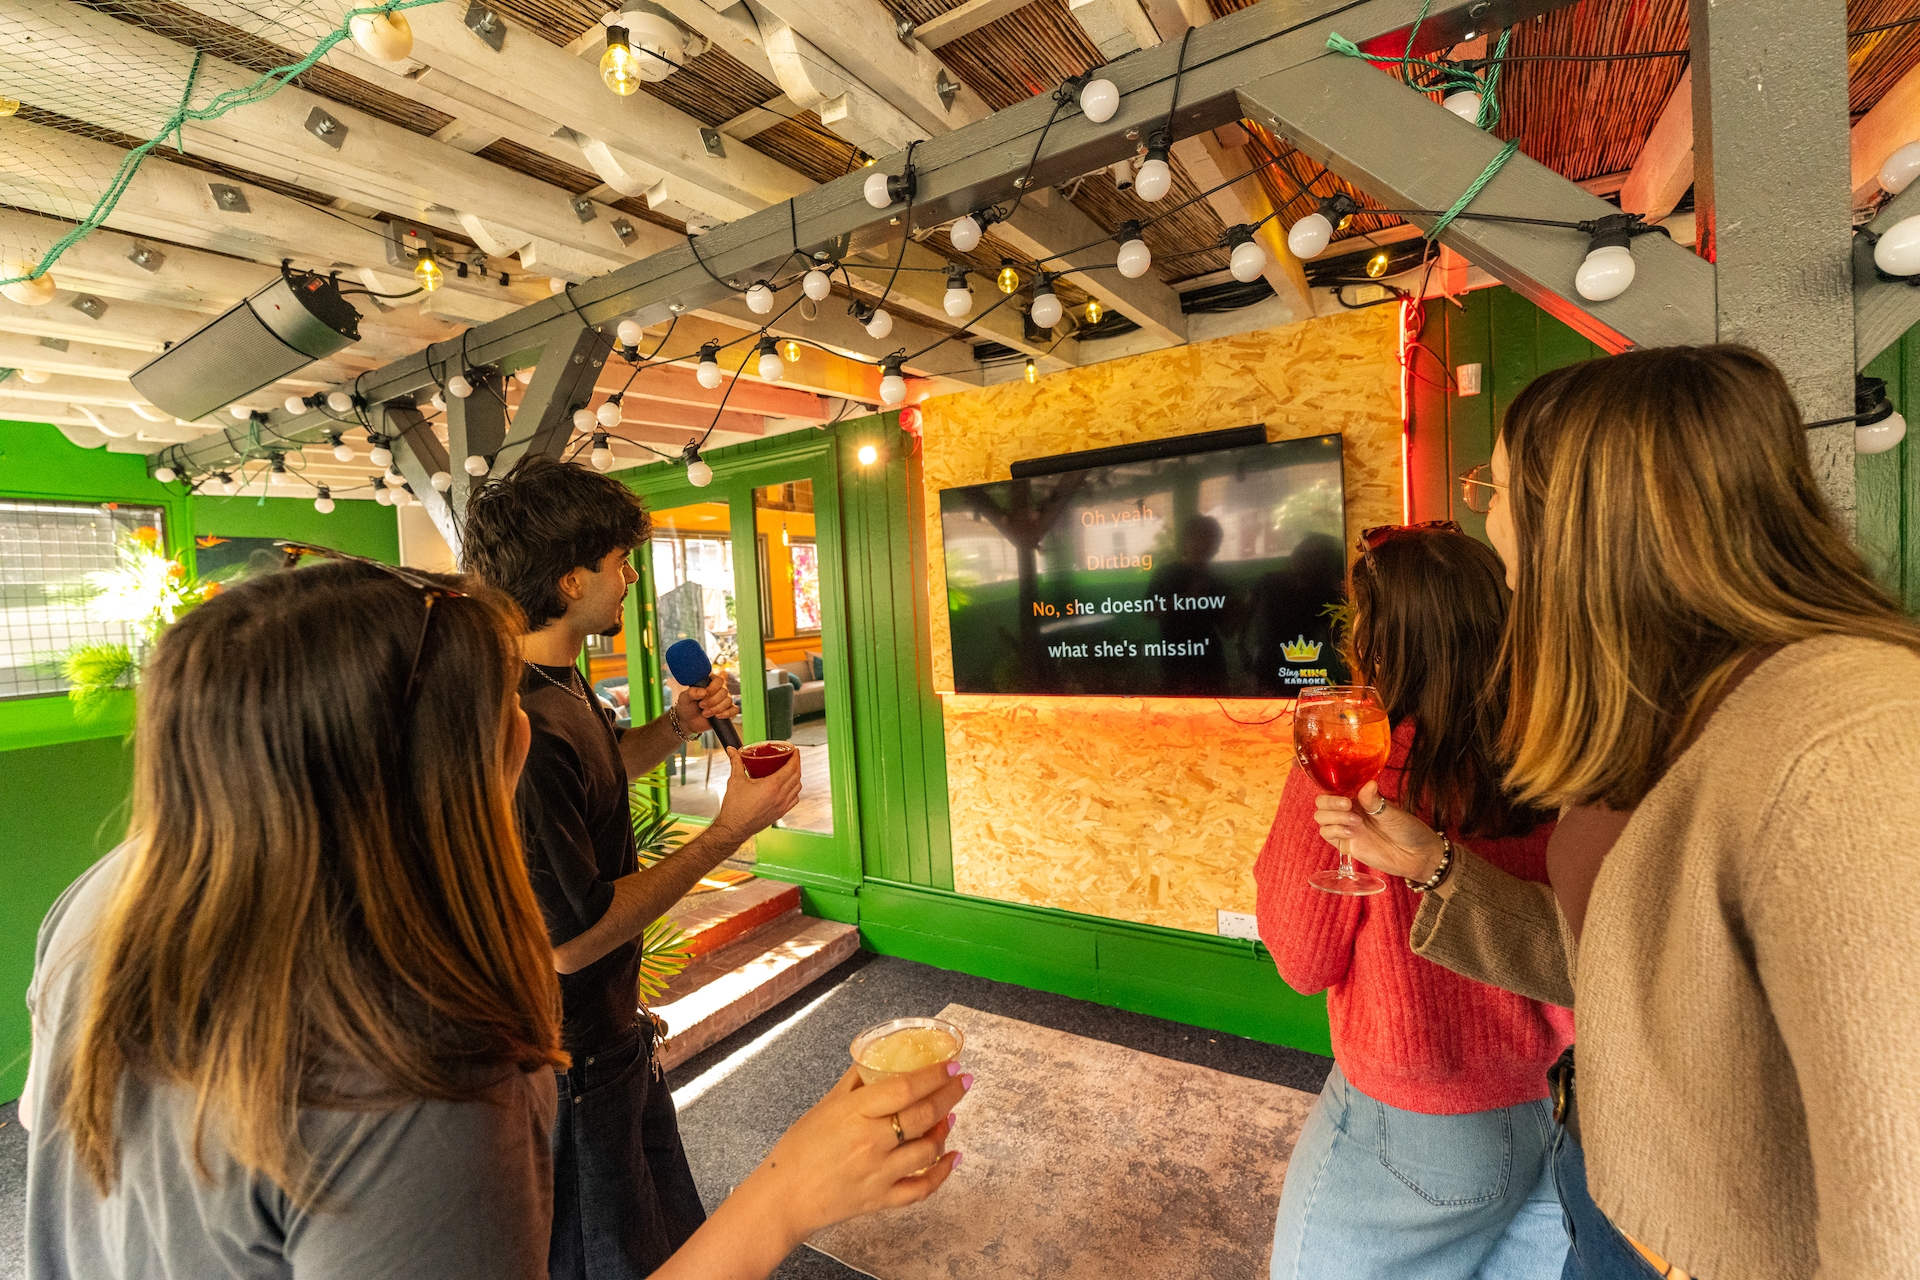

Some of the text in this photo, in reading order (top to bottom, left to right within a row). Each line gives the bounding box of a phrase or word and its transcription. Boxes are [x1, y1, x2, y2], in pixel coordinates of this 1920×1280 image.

[1081, 505, 1153, 528] Oh yeah
[1087, 553, 1153, 571] Dirtbag
[1033, 593, 1226, 618] No, she doesn't know
[1048, 638, 1210, 658] what she's missin'
